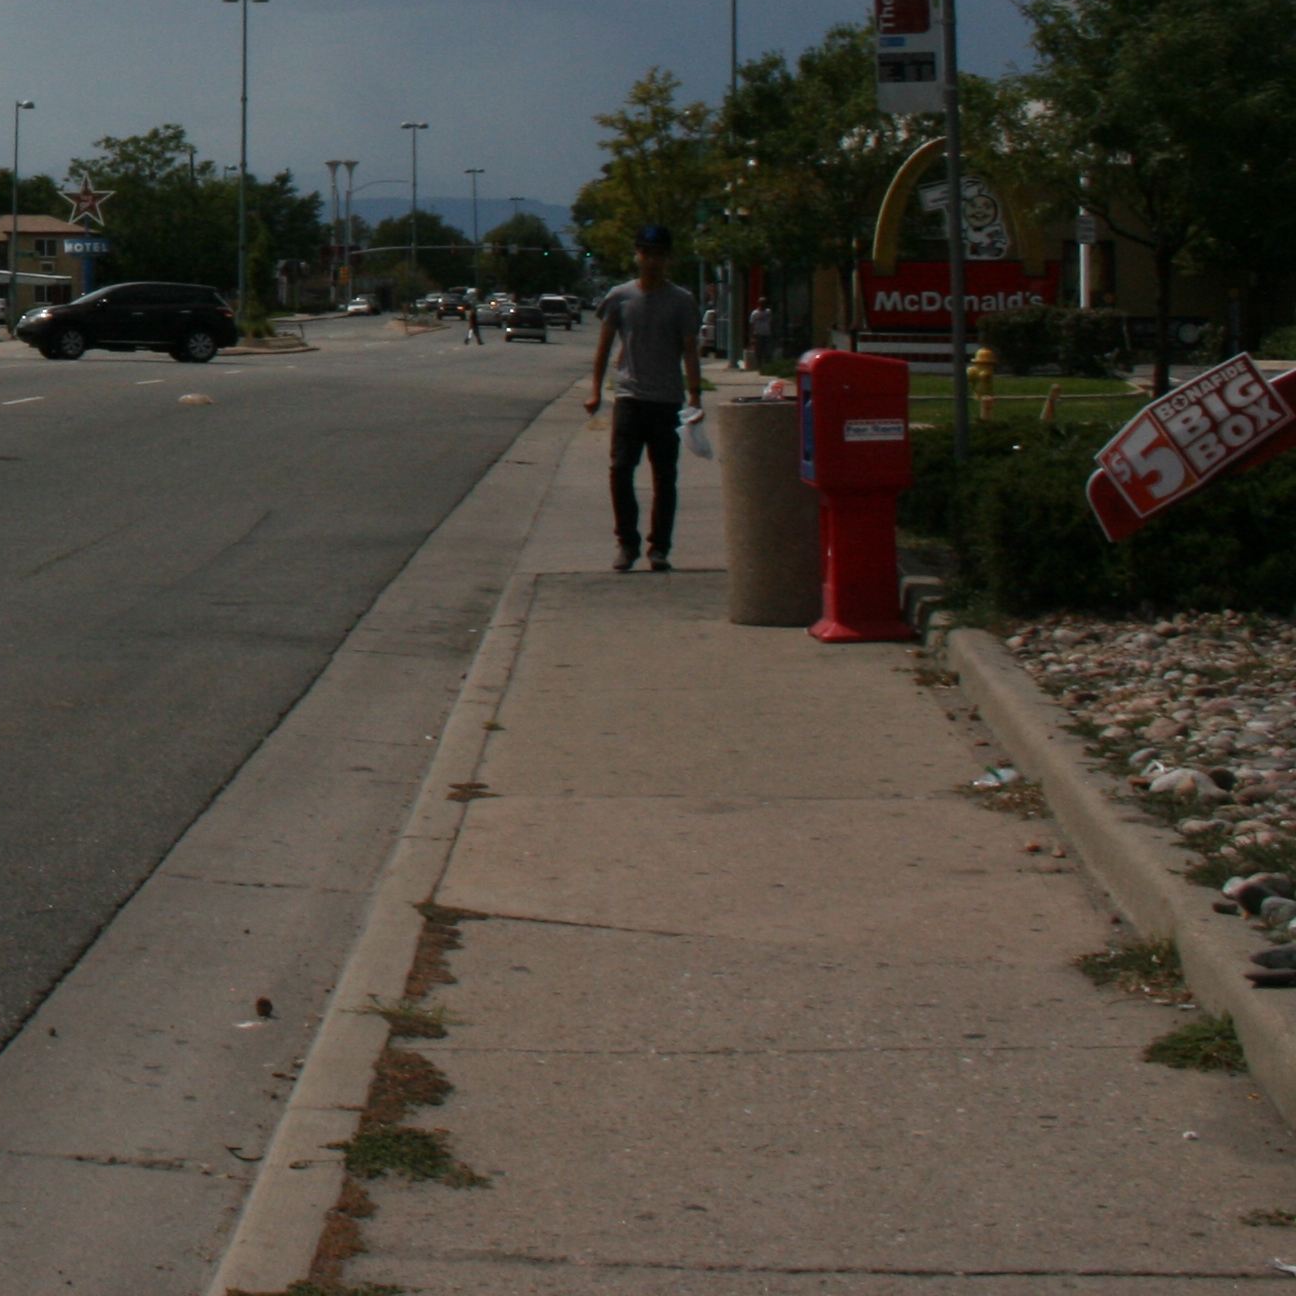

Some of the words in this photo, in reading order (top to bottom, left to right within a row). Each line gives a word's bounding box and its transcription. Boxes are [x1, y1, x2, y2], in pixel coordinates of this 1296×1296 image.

[64, 242, 109, 253] MOTEL
[1153, 360, 1247, 421] BONAFIDE
[1165, 373, 1265, 447] BIG
[1109, 417, 1185, 499] $5
[1183, 395, 1283, 473] BOX
